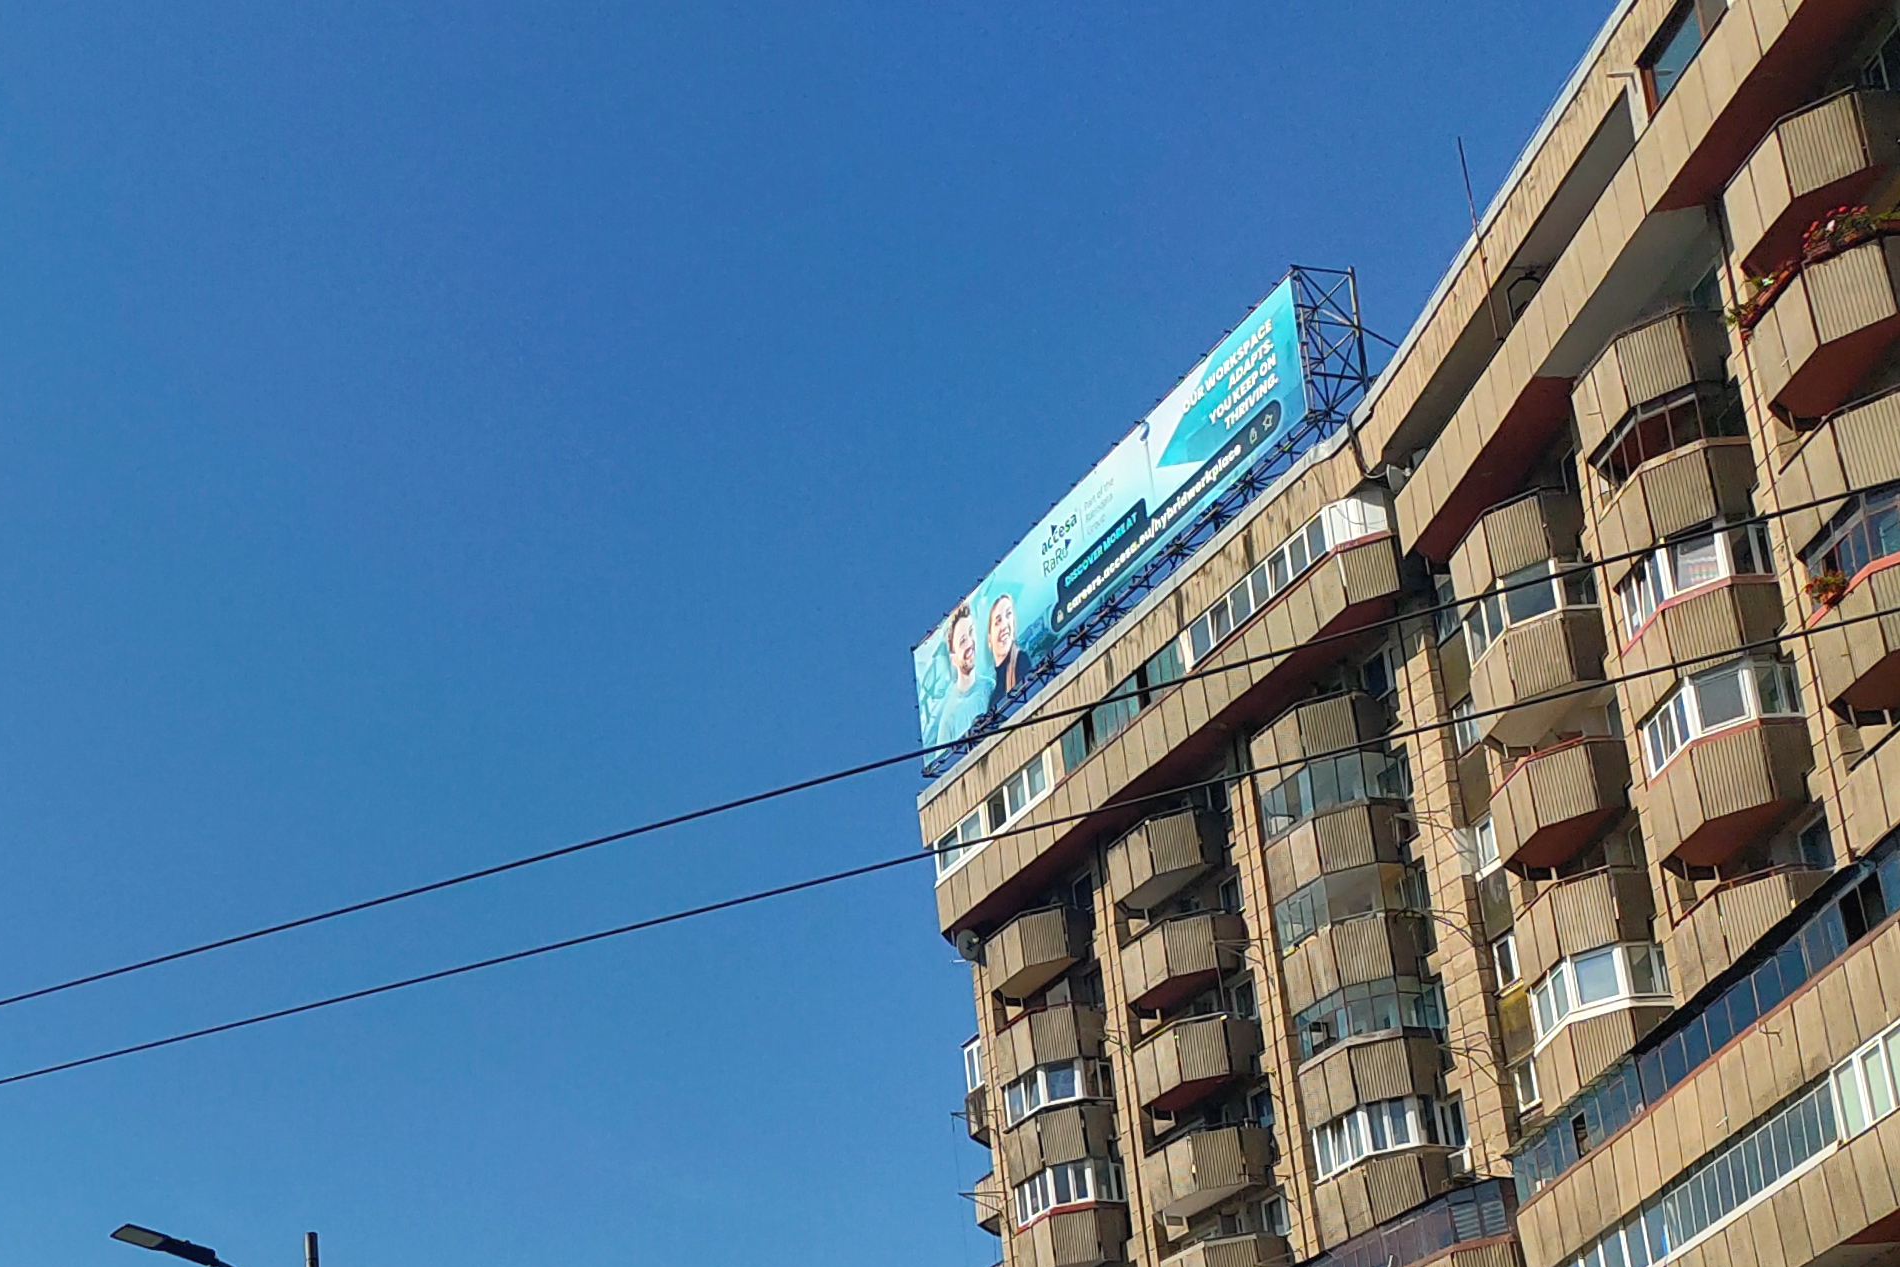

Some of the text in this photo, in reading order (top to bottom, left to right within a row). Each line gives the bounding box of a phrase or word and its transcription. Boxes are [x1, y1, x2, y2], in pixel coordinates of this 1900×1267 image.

[1182, 318, 1273, 413] OUR WORKSPACE
[1209, 353, 1277, 425] YOU KEEP ON
[1227, 339, 1275, 389] ADAPTS.
[1224, 373, 1280, 430] THRIVING.
[1041, 513, 1078, 555] accesa
[1064, 512, 1138, 588] DISCOVER MORE AT
[1066, 443, 1242, 613] careers.accesa.eu/hybridworkplace
